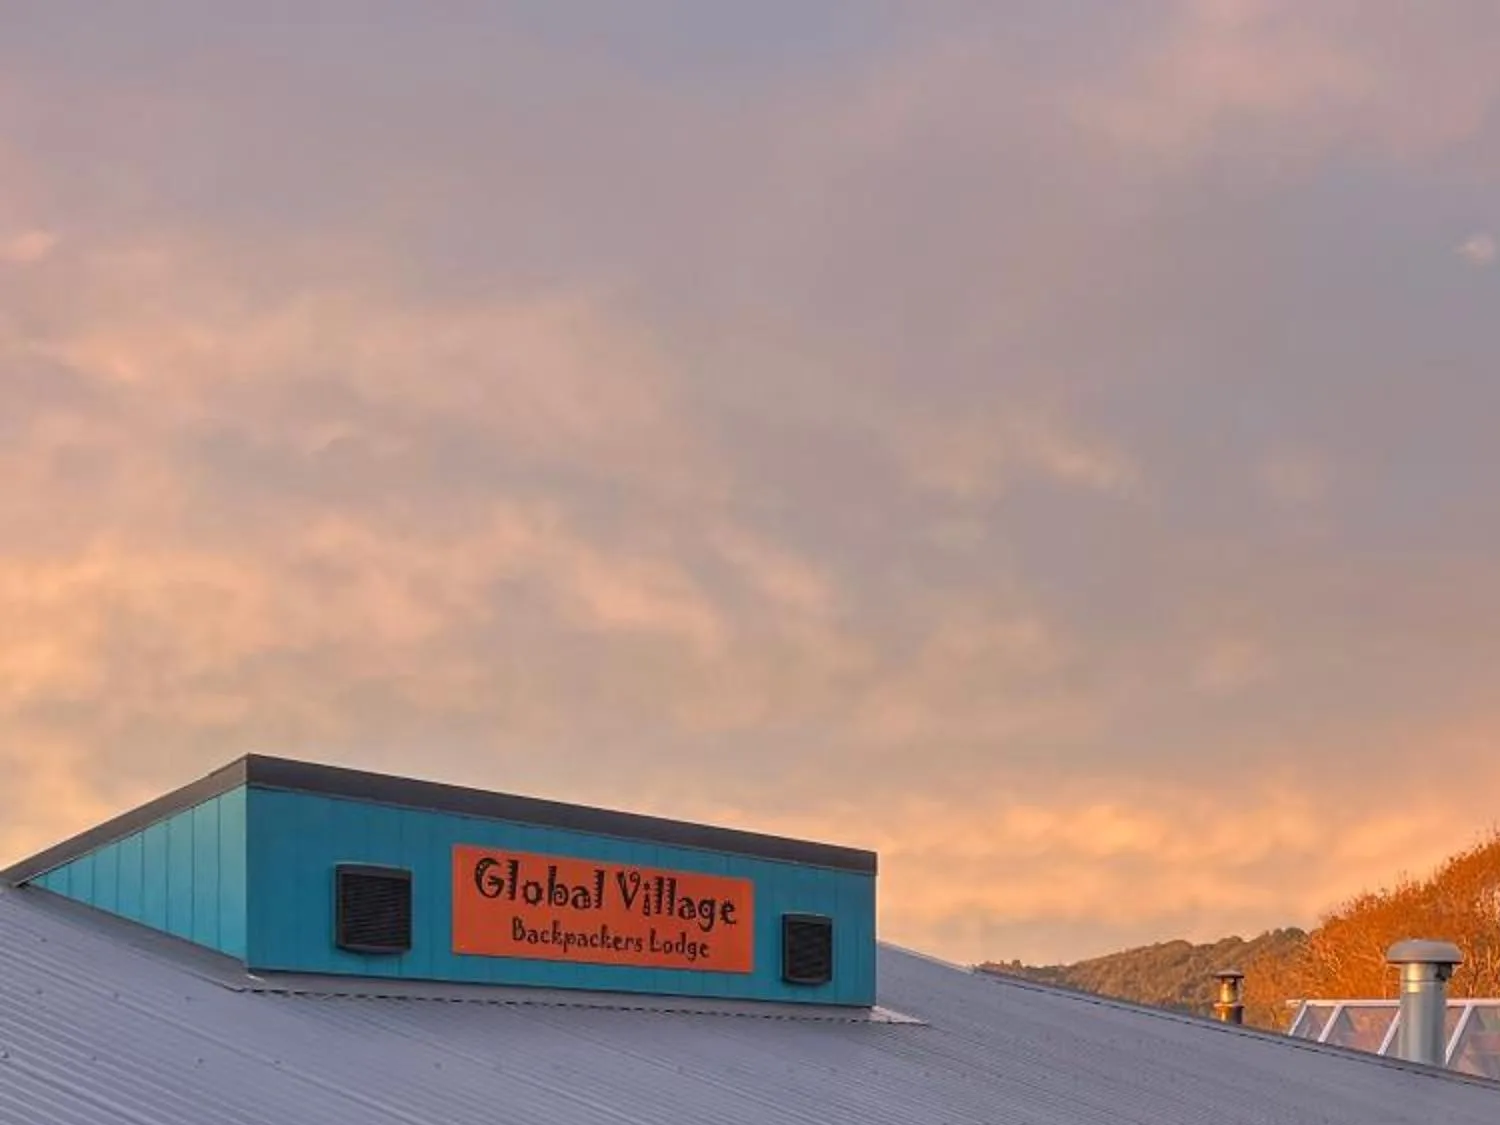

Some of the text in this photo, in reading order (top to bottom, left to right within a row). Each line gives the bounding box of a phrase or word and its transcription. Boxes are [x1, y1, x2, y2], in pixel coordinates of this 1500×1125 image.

[474, 857, 737, 932] Global Village
[512, 915, 710, 961] Backpackers Lodge
